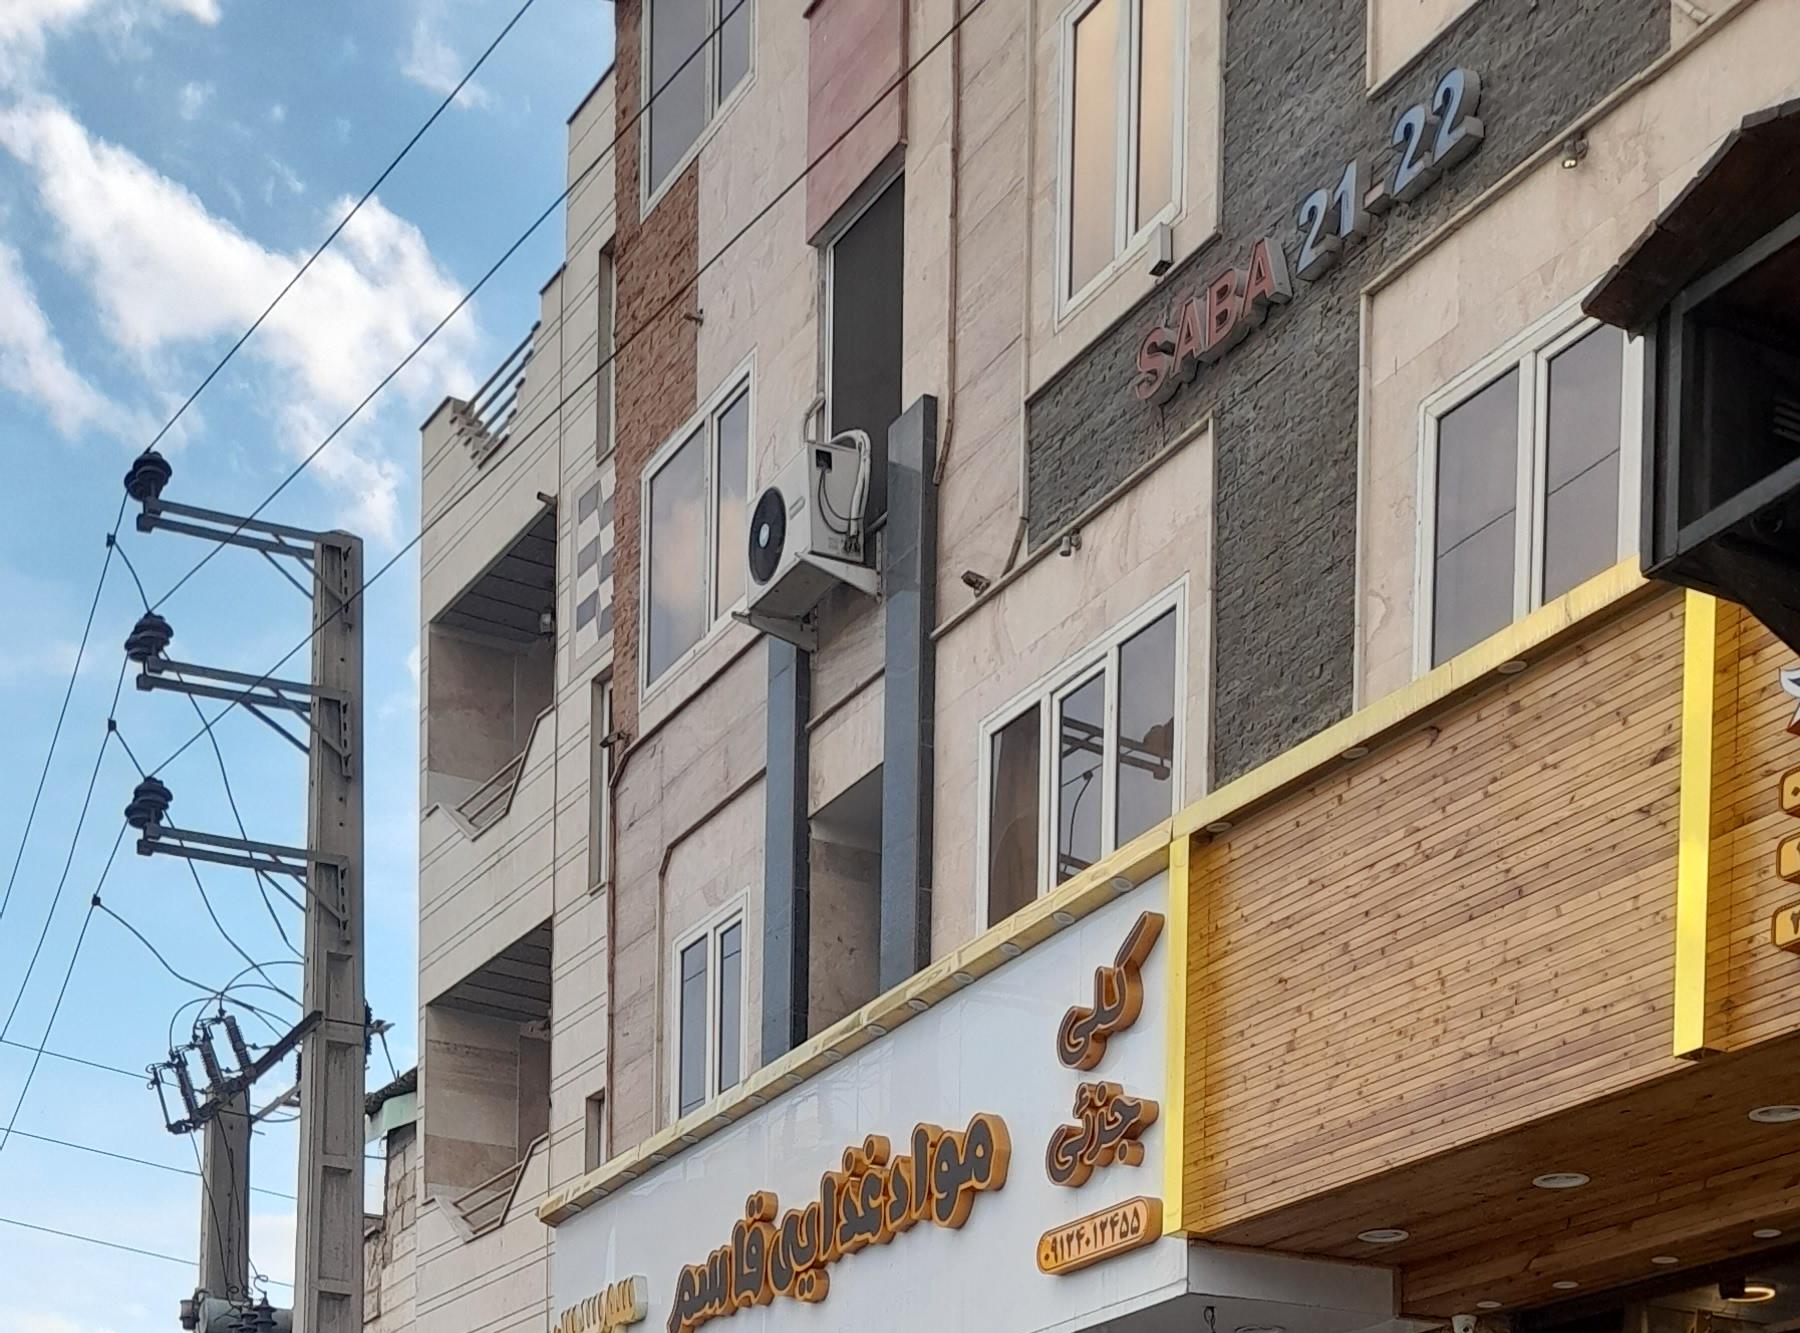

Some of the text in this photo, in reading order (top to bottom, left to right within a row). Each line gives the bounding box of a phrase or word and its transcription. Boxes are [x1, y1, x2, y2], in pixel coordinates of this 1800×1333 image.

[1136, 68, 1484, 402] SABA 21-22
[1057, 911, 1165, 1070] کلی
[888, 1112, 1011, 1231] مواد
